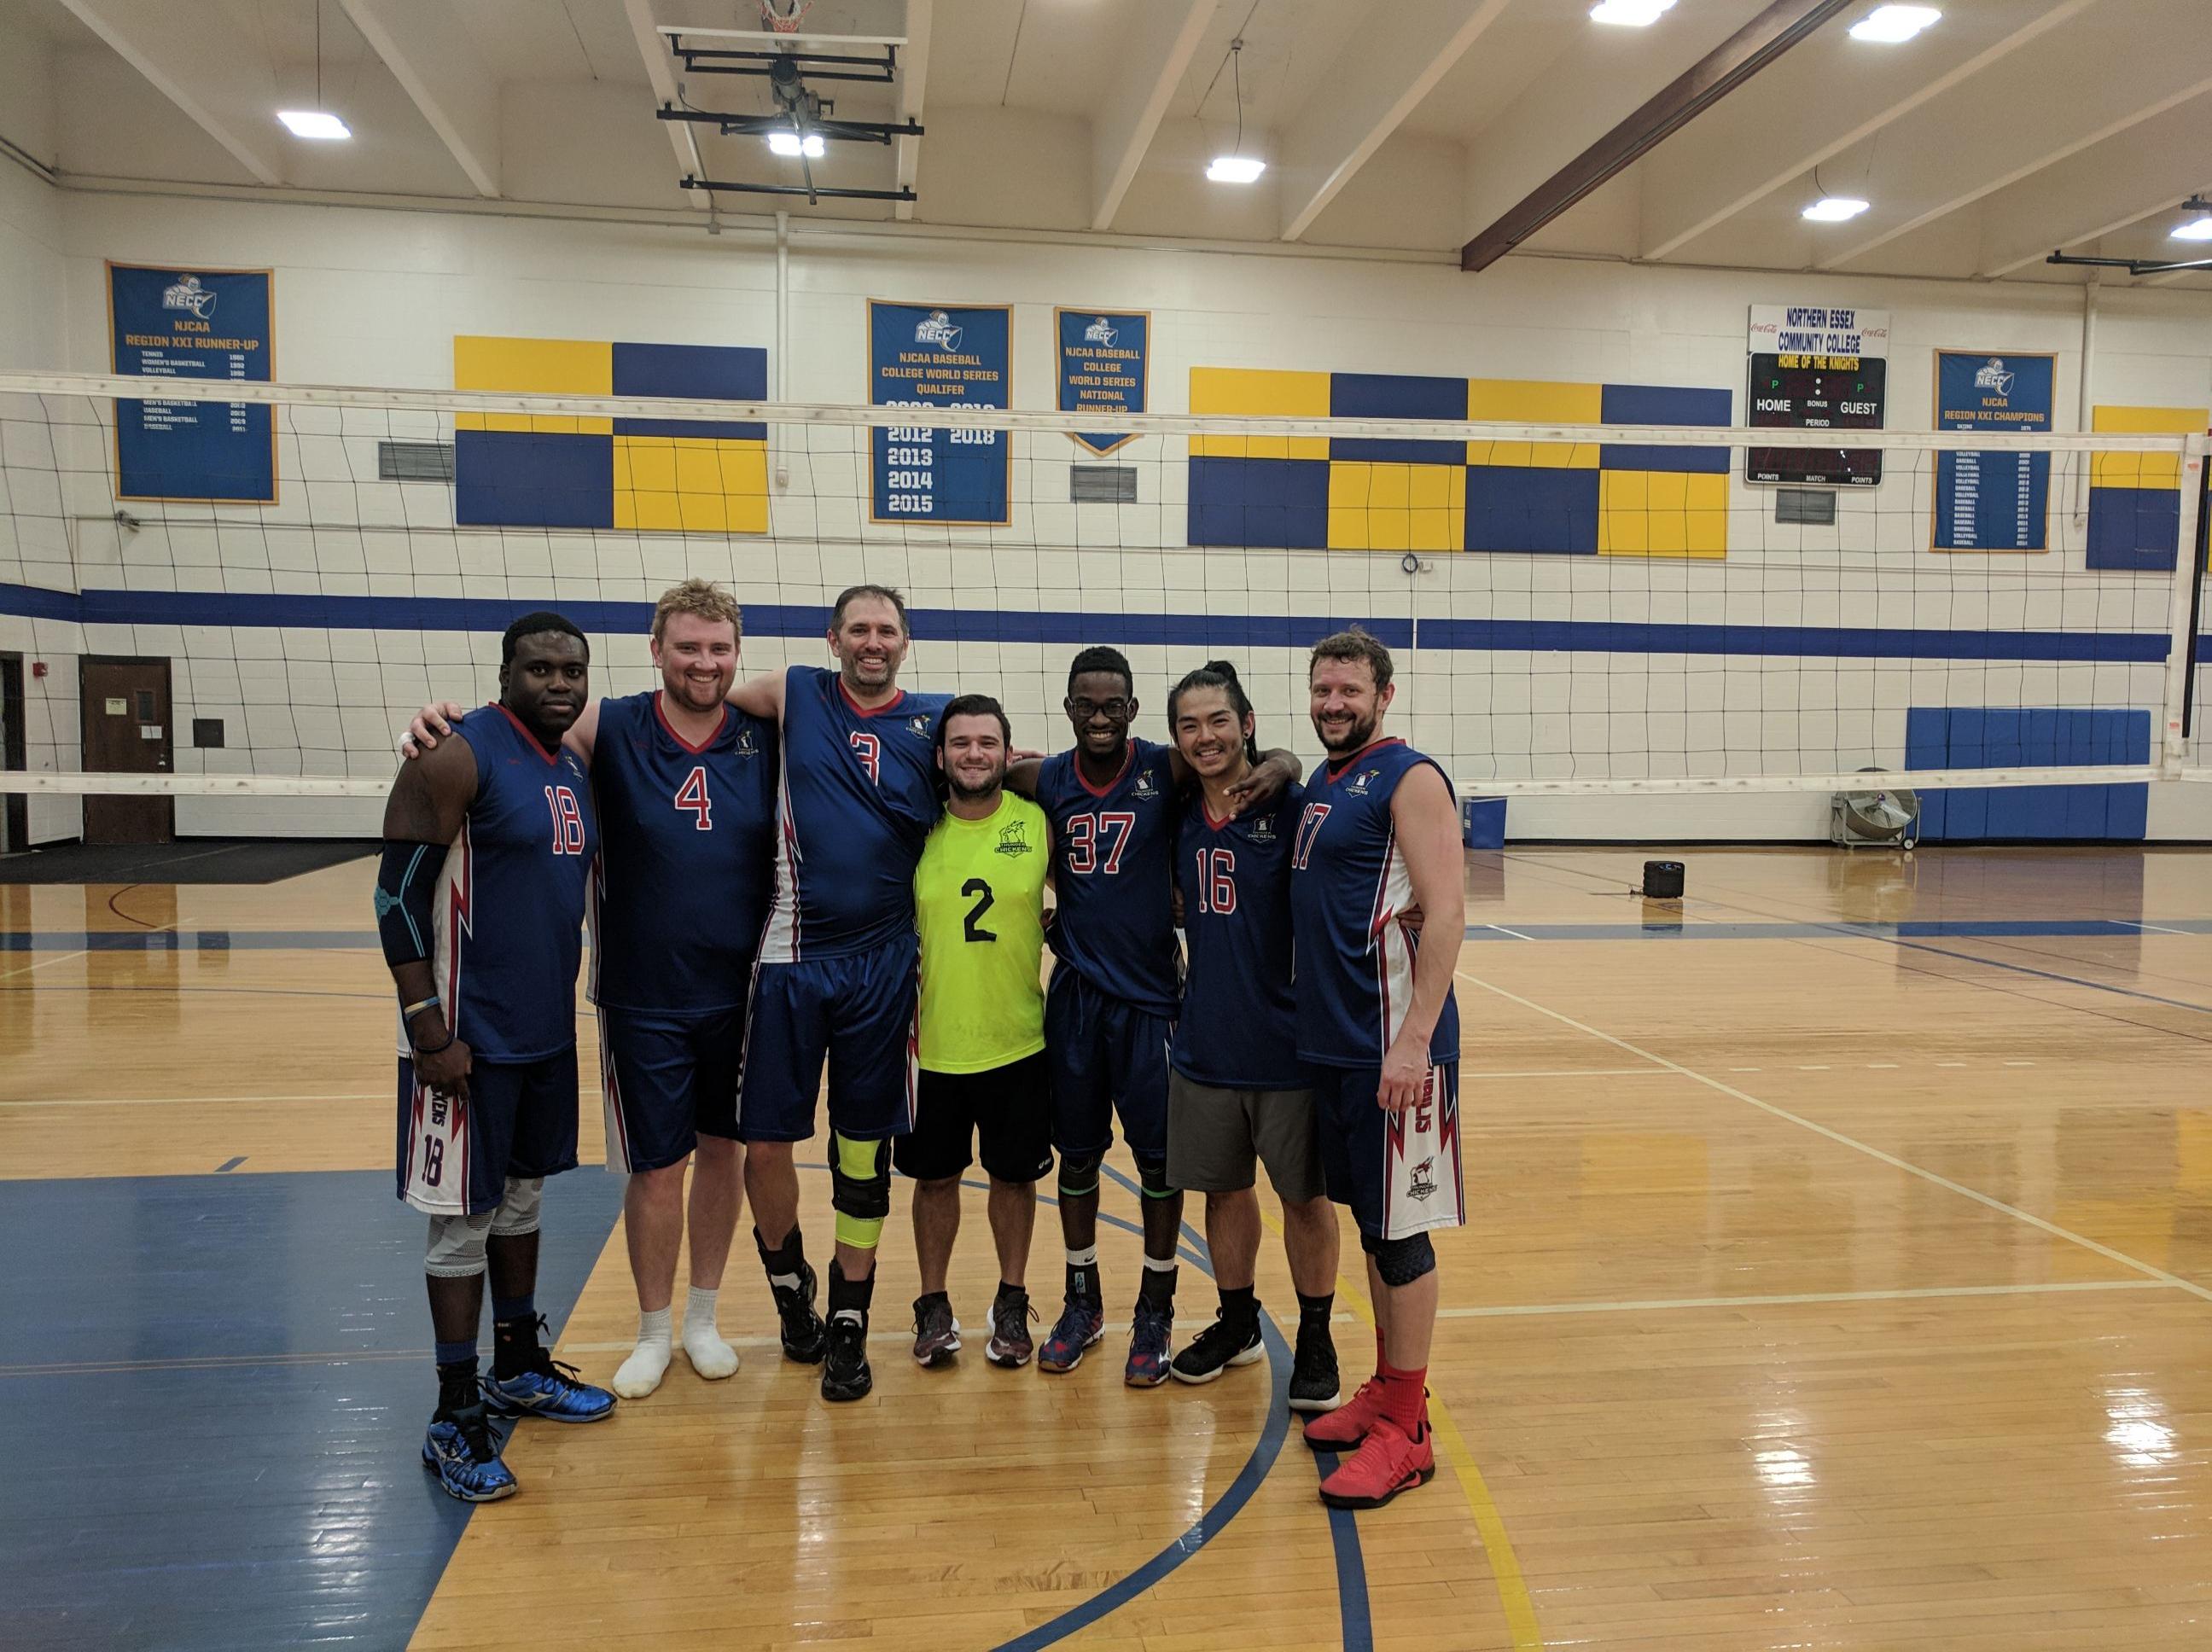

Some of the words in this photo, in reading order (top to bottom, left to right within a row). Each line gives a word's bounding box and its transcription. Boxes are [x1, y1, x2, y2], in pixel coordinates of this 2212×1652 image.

[166, 294, 204, 307] NECC
[1786, 307, 1828, 329] NORTHERN
[1830, 309, 1856, 330] ESSEX
[175, 320, 210, 332] NJCAA
[917, 329, 952, 341] NECC
[1086, 330, 1110, 340] NECC
[125, 334, 169, 347] REGION
[172, 336, 193, 348] XXI
[195, 337, 259, 351] RUNNER-UP
[1778, 332, 1825, 352] COMMUNITY
[1826, 334, 1861, 354] COLLEGE
[899, 352, 931, 364] NJCAA
[933, 353, 982, 366] BASEBALL
[1065, 346, 1093, 358] NJCAA
[1095, 348, 1140, 359] BASEBALL
[170, 359, 206, 368] BASKETBALL
[1083, 362, 1122, 373] COLLEGE
[1778, 354, 1799, 369] HOME
[1801, 355, 1811, 369] OF
[1813, 355, 1827, 370] THE
[1829, 356, 1860, 371] KNIGHTS
[882, 367, 924, 379] COLLEGE
[926, 368, 961, 380] WORLD
[963, 369, 999, 381] SERIES
[1068, 375, 1101, 387] WORLD
[1103, 376, 1136, 387] SERIES
[1976, 375, 2005, 387] NECC
[916, 383, 965, 396] QUALIFER
[1080, 389, 1125, 401] NATIONAL
[1076, 404, 1128, 413] RUNNER-UP
[1756, 398, 1791, 412] HOME
[1807, 399, 1828, 408] BONUS
[1840, 401, 1877, 415] GUEST
[1982, 397, 2008, 407] NJCAA
[1805, 418, 1830, 428] PERIOD
[1944, 410, 1976, 421] REGION
[1977, 410, 1993, 422] XXI
[1994, 411, 2045, 422] CHAMPIONS
[888, 427, 933, 443] 2012
[950, 428, 995, 445] 2018
[888, 447, 933, 466] 2013
[888, 471, 933, 490] 2014
[1757, 473, 1779, 481] POINTS
[1851, 476, 1873, 485] POINTS
[888, 494, 933, 513] 2015
[850, 730, 880, 787] 3
[674, 766, 713, 830] 4
[544, 784, 585, 855] 18
[1066, 811, 1136, 875] 37
[1291, 802, 1332, 870] 17
[1196, 848, 1236, 915] 16
[961, 878, 998, 943] 2
[422, 1134, 445, 1188] 18
